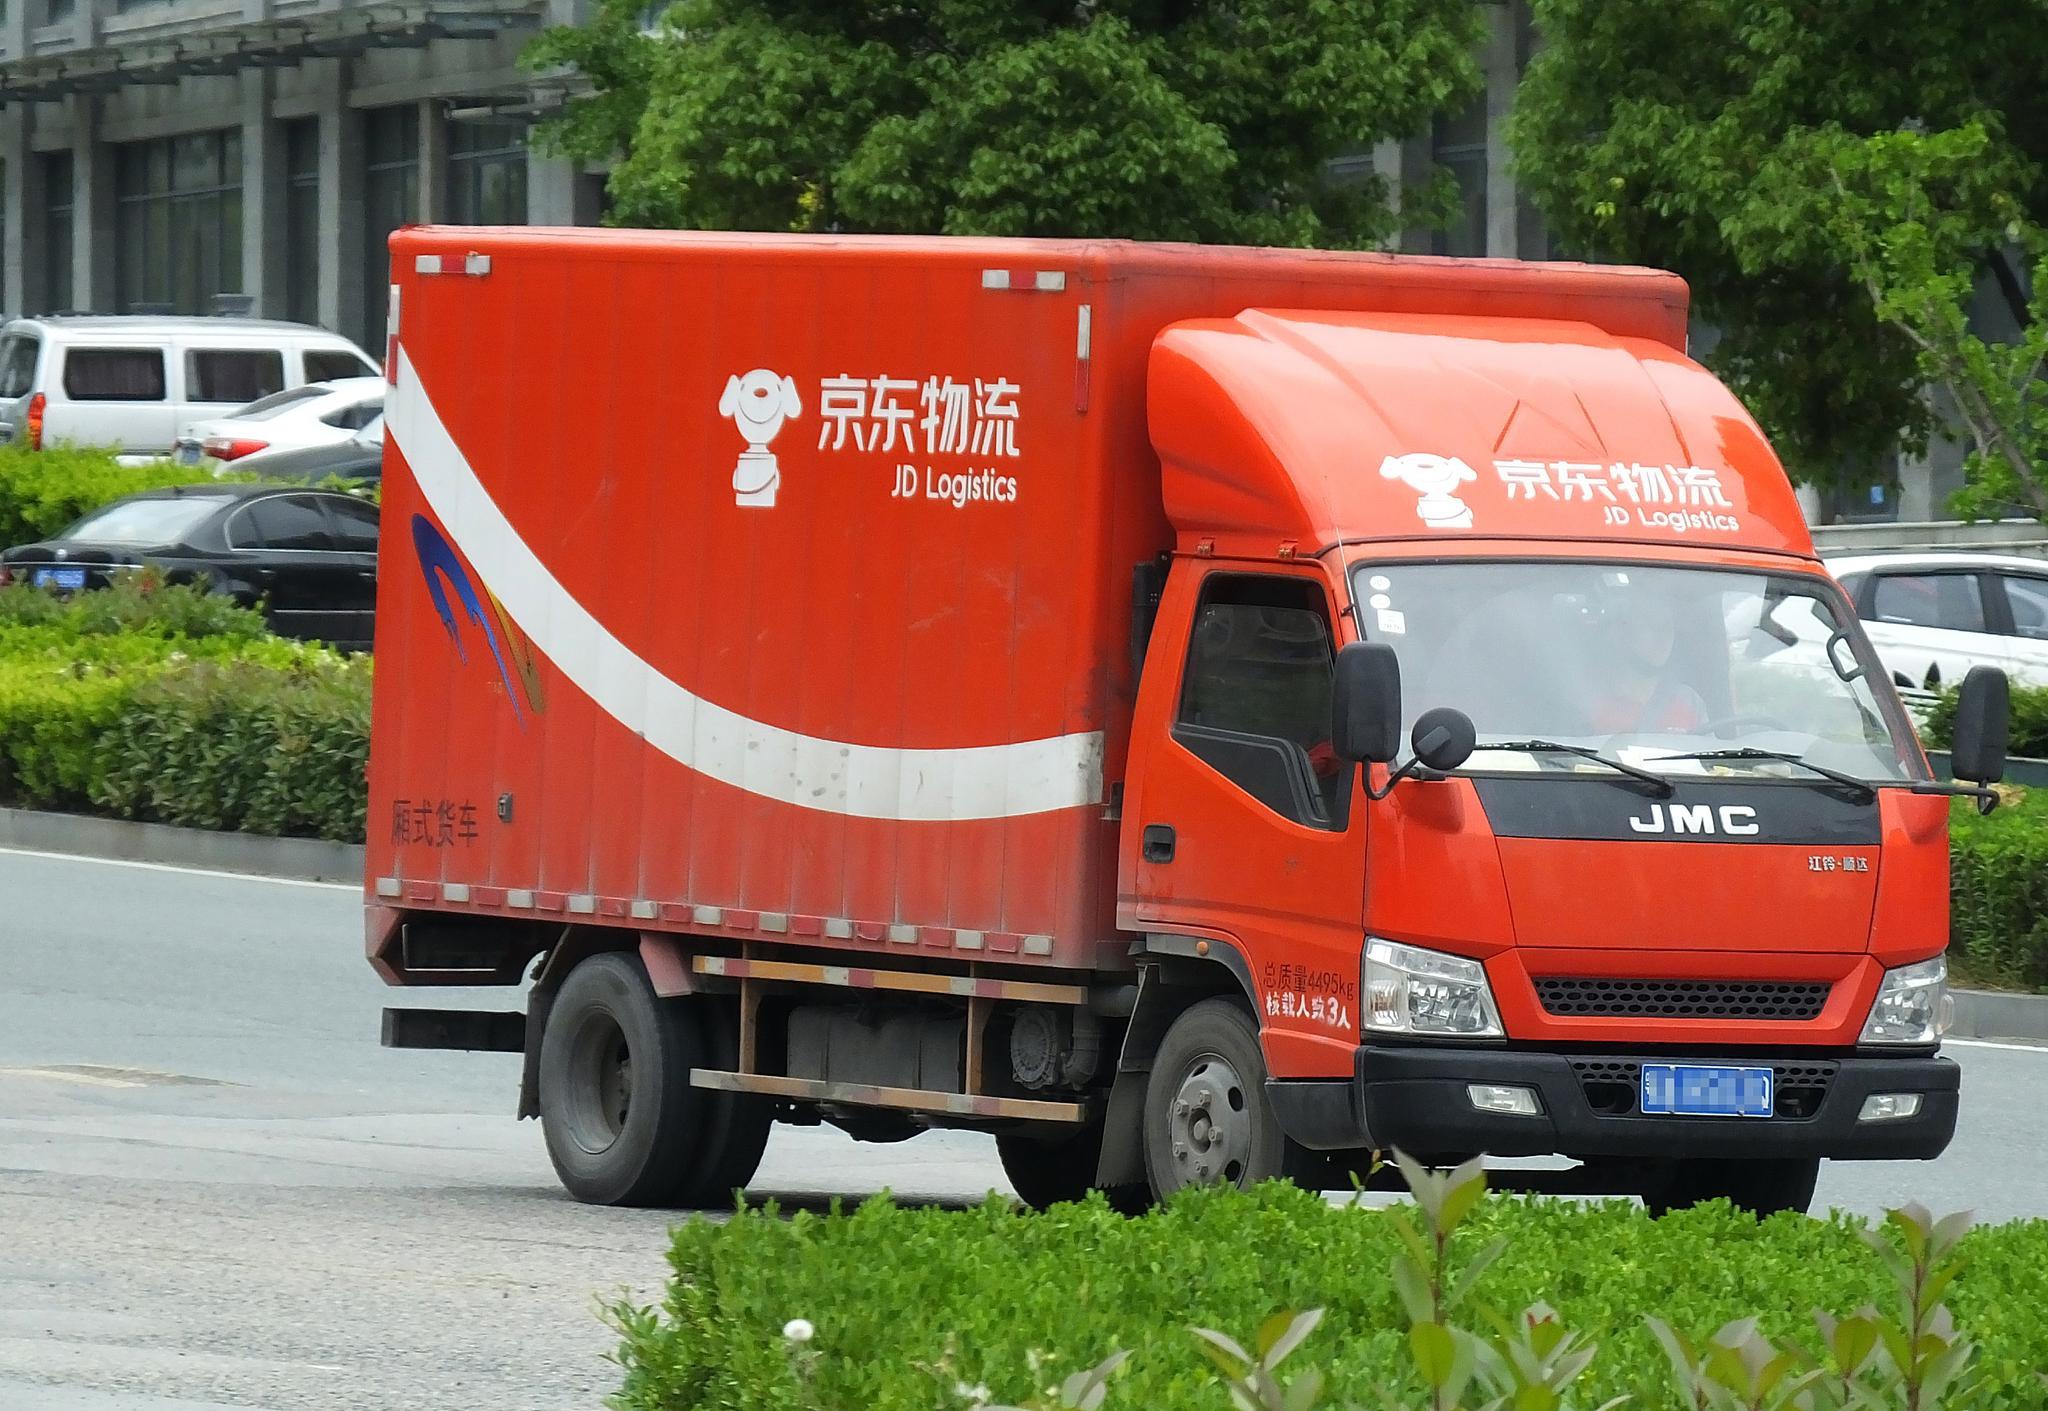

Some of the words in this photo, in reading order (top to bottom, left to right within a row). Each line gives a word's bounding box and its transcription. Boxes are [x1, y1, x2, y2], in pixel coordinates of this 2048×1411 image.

[817, 373, 1021, 457] 京东物流
[891, 464, 918, 498] JD
[926, 464, 1018, 508] Logistics
[1492, 459, 1734, 507] 京东物流
[1604, 505, 1630, 526] JD
[1637, 507, 1740, 533] Logistics
[1629, 803, 1760, 835] JMC
